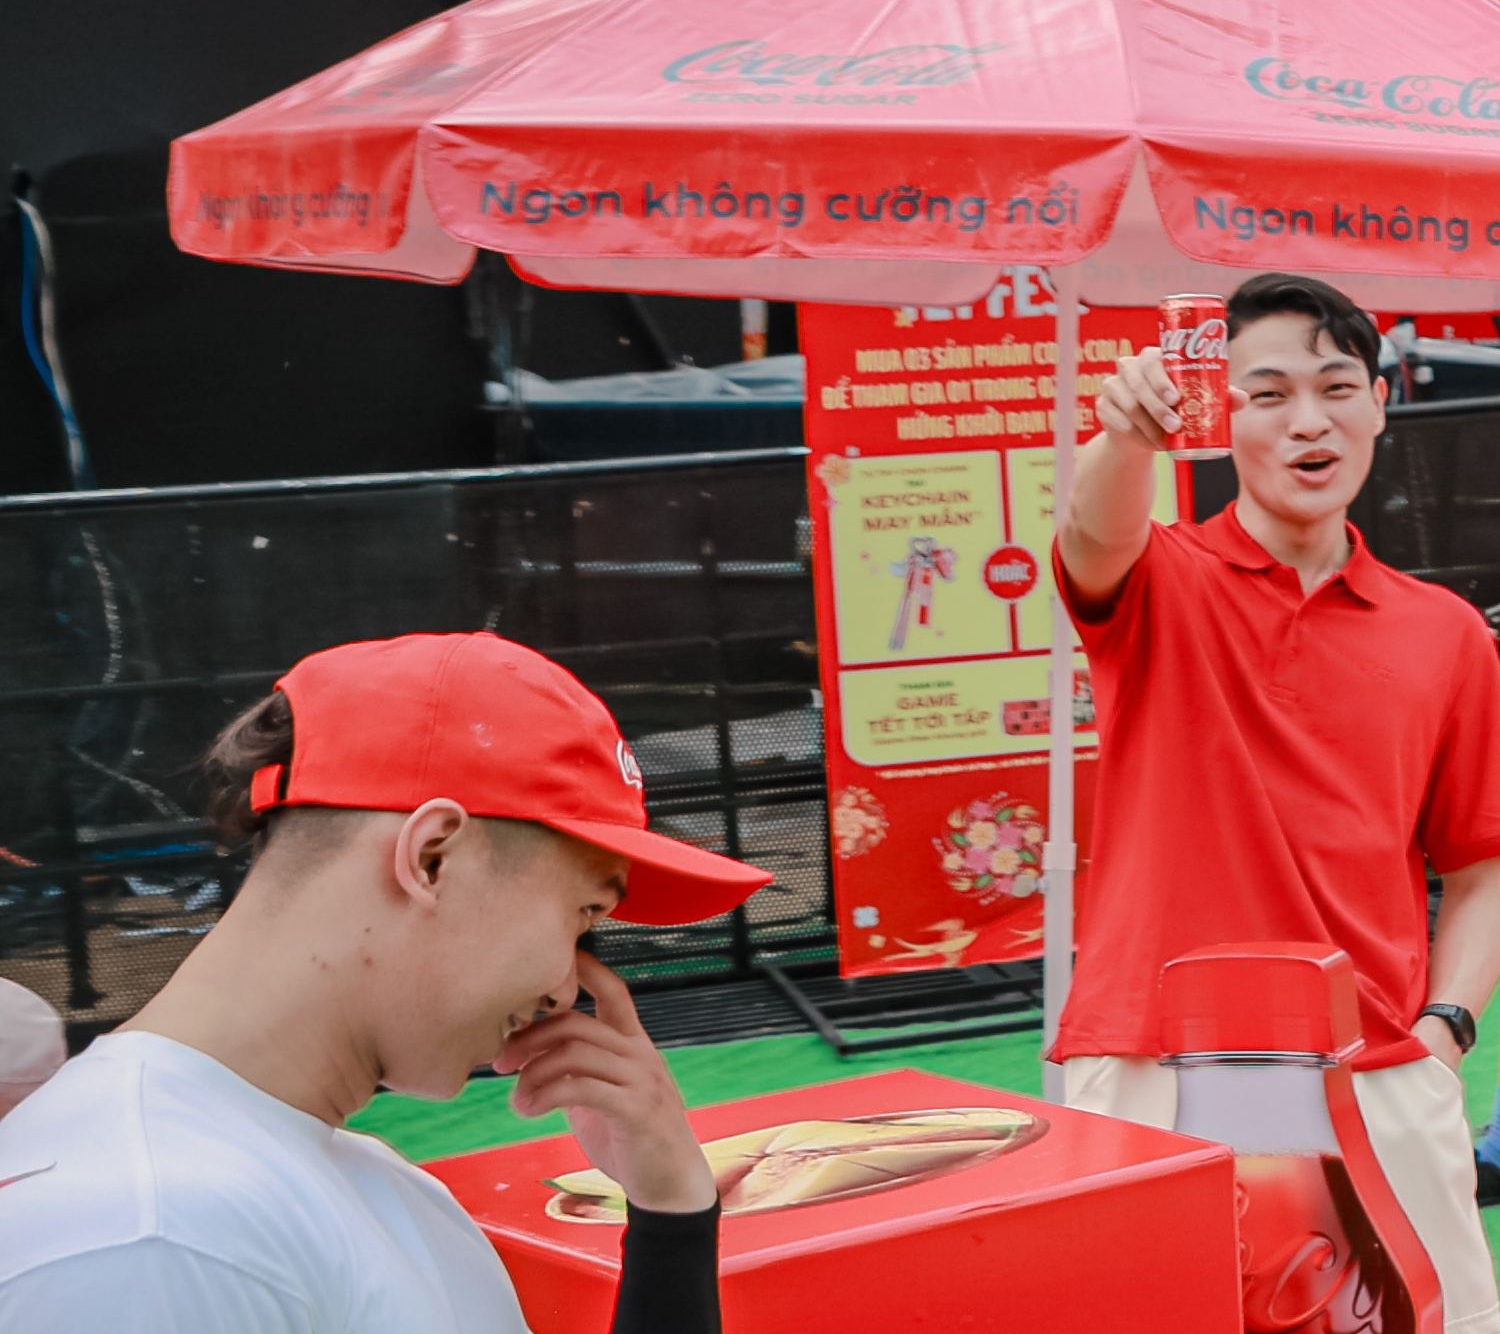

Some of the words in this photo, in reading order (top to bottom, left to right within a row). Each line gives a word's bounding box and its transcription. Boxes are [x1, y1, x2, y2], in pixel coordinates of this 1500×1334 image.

[478, 180, 623, 225] Ngon
[643, 180, 806, 228] không
[824, 183, 986, 232] cưỡng
[1005, 180, 1081, 225] nổi
[1192, 195, 1315, 242] Ngon
[1333, 204, 1471, 251] không
